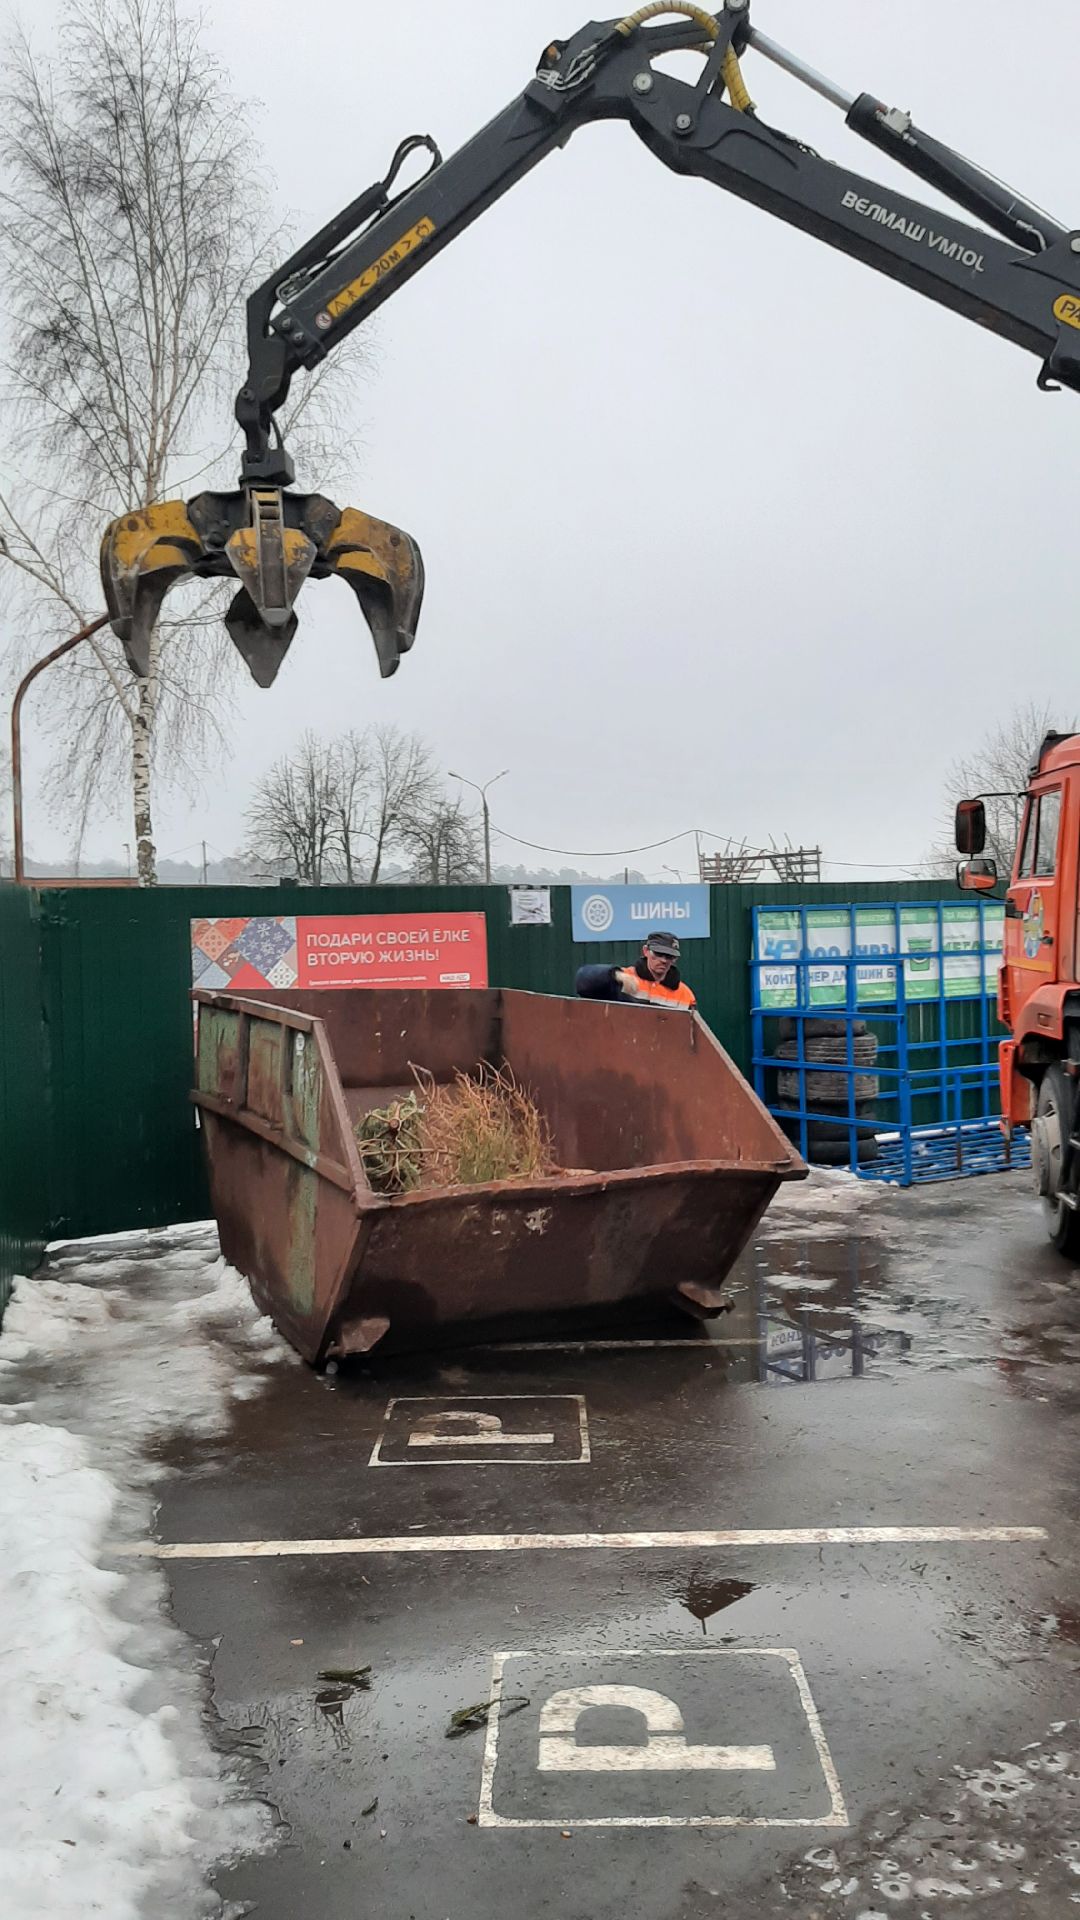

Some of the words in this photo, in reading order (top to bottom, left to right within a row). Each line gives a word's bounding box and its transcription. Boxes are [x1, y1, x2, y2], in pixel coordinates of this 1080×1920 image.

[631, 902, 690, 920] ШИНЫ
[306, 933, 373, 948] ПОДАРИ
[376, 929, 428, 946] СВОЕЙ
[433, 929, 471, 943] ЁЛКЕ
[307, 949, 375, 967] ВТОРУЮ
[378, 948, 439, 964] ЖИЗНЬ!
[765, 970, 829, 985] КОНТНЕР
[857, 967, 883, 981] ШИН
[537, 1684, 776, 1771] P
